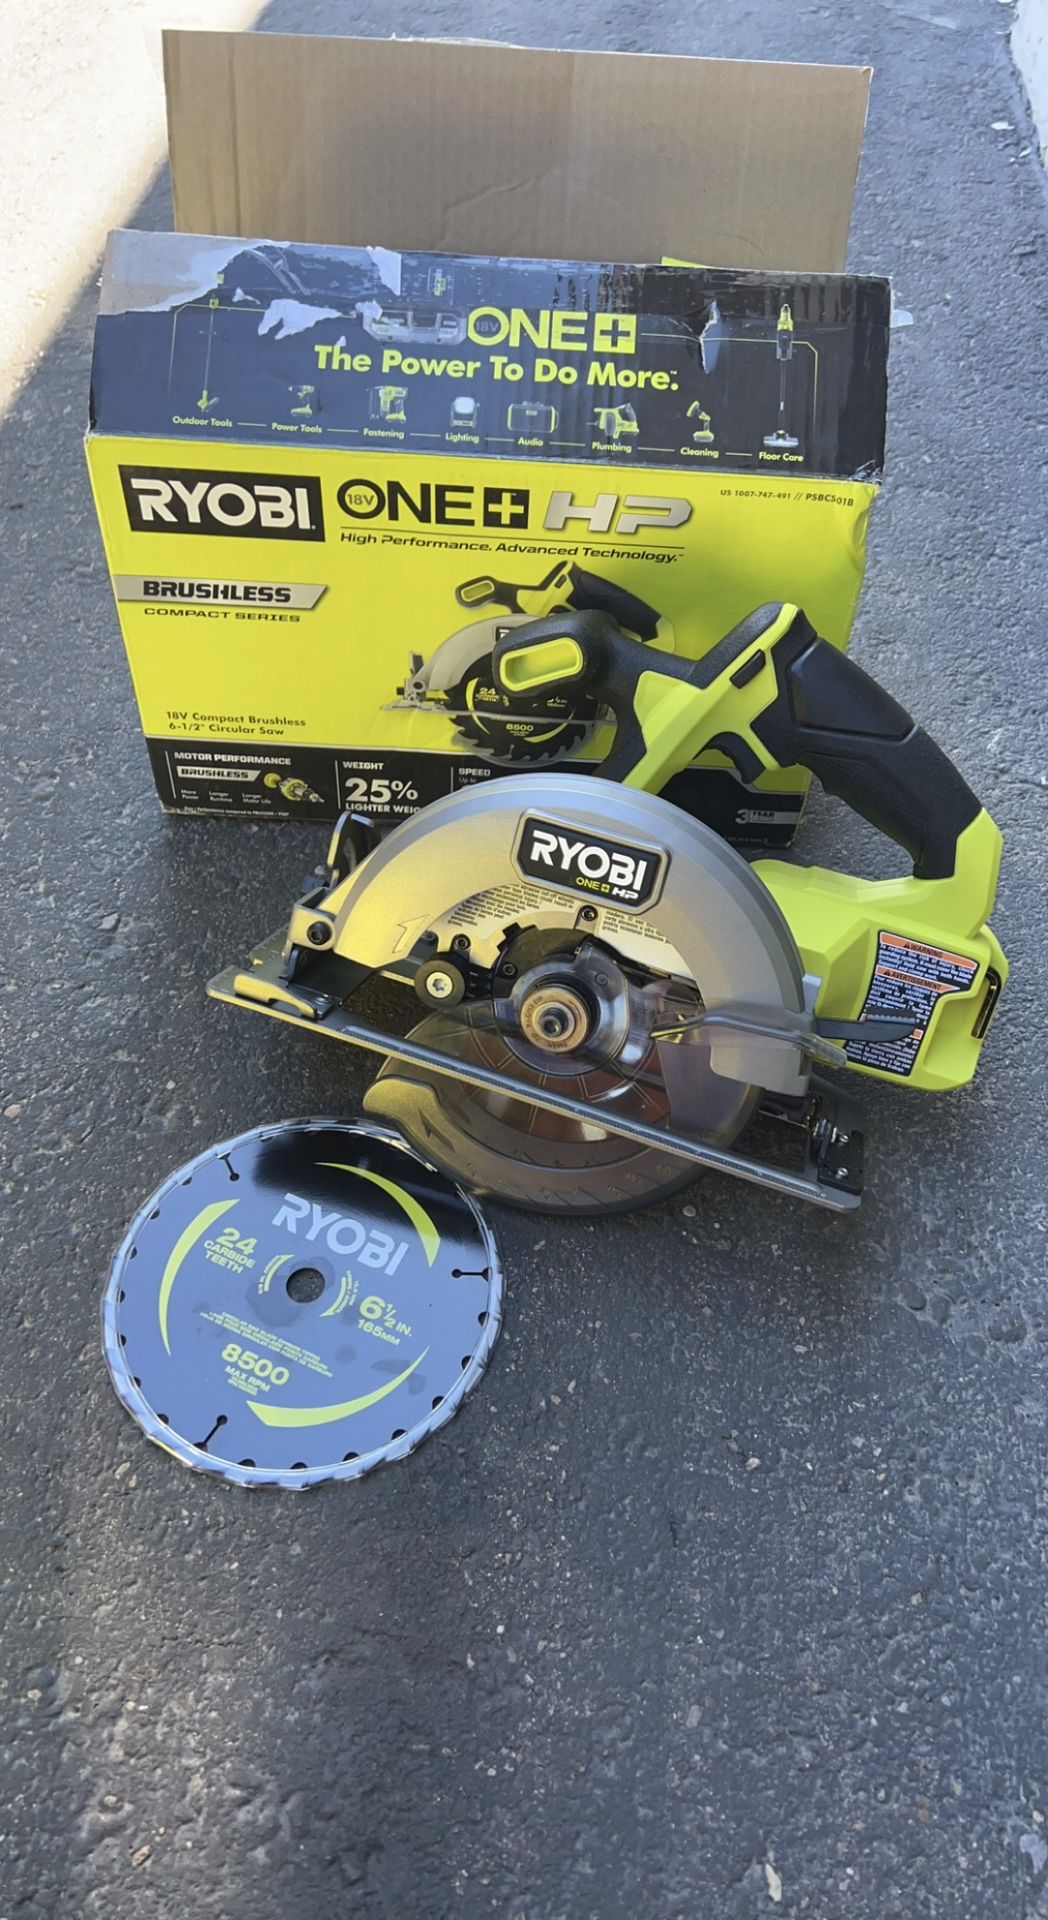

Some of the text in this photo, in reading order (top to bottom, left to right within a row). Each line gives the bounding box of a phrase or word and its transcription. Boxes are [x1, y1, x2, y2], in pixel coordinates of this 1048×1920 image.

[314, 344, 679, 391] The Power To Do More.
[172, 415, 233, 427] Outdoor Tools
[272, 422, 323, 434] Power Tools
[363, 428, 405, 440] Fastening
[445, 432, 480, 444] Lighting
[517, 436, 544, 447] Audio
[592, 441, 632, 453] Plumbing
[680, 447, 719, 459] Cleaning
[758, 451, 804, 462] Floor Care
[130, 478, 313, 530] RYOBI
[347, 492, 375, 507] 18V
[735, 490, 791, 500] 1007-747-491
[806, 493, 854, 507] PSBCS01B
[543, 490, 693, 535] HP
[340, 532, 377, 546] High
[381, 535, 493, 553] Performance.
[495, 542, 578, 557] Advanced
[143, 580, 291, 603] BRUSHLESS
[144, 607, 301, 623] COMPACT SERIES
[166, 711, 306, 727] 18V Compact Brushless
[209, 724, 255, 735] Circular
[259, 726, 284, 736] Saw
[174, 752, 292, 766] MOTOR PERFORMANCE
[343, 761, 384, 771] WEIGHT
[180, 768, 249, 779] BRUSHLESS
[458, 767, 491, 777] SPEED
[345, 777, 419, 804] 25%
[345, 803, 421, 814] LIGHTER WEIG
[735, 808, 750, 824] 3
[530, 829, 648, 891] RYOBI
[611, 886, 639, 900] HP
[911, 943, 943, 959] WARNING
[216, 1227, 258, 1256] 24
[271, 1192, 409, 1277] RYOBI
[203, 1239, 256, 1269] CARBIDE
[205, 1250, 244, 1274] TEETH
[357, 1319, 401, 1346] 165MM
[221, 1343, 290, 1386] 8500
[224, 1365, 247, 1382] MAX
[247, 1375, 270, 1393] RPM
